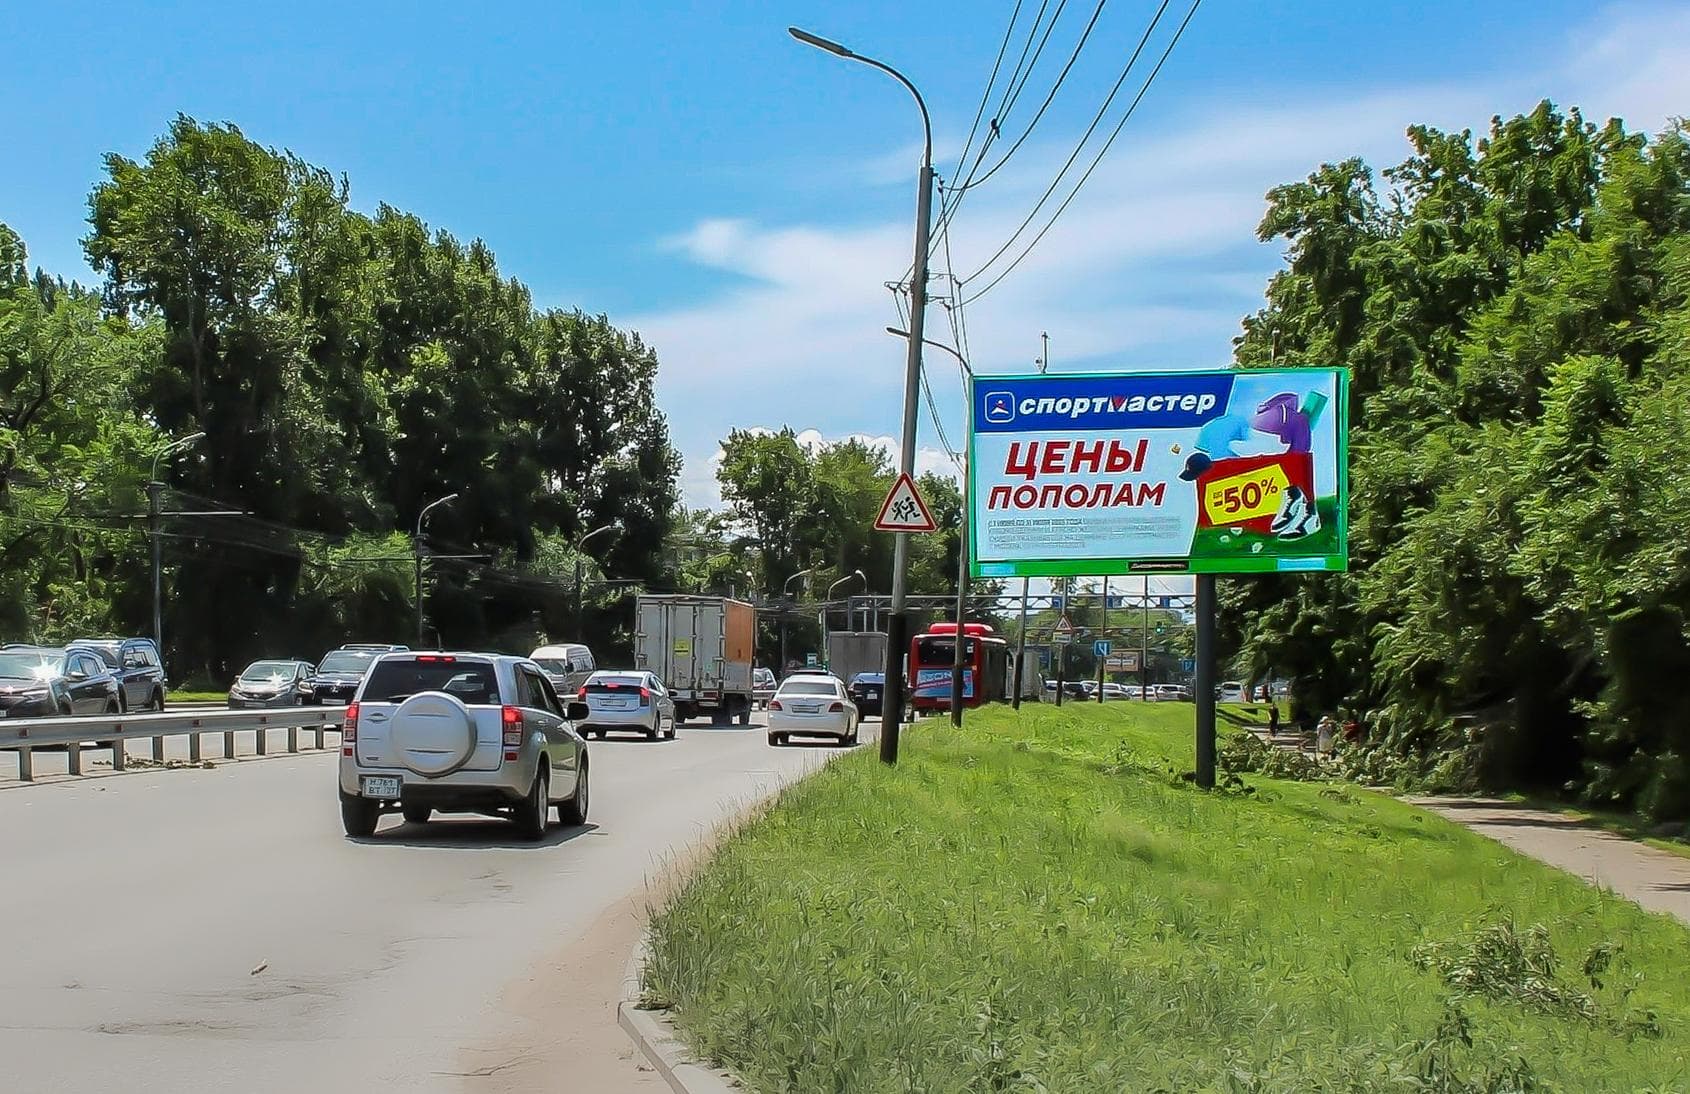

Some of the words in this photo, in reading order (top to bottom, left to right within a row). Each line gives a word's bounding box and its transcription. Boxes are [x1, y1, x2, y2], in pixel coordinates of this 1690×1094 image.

[1019, 394, 1216, 418] спортмастер
[1005, 439, 1149, 480] ЦЕНЫ
[988, 483, 1166, 509] ПОПОЛАМ
